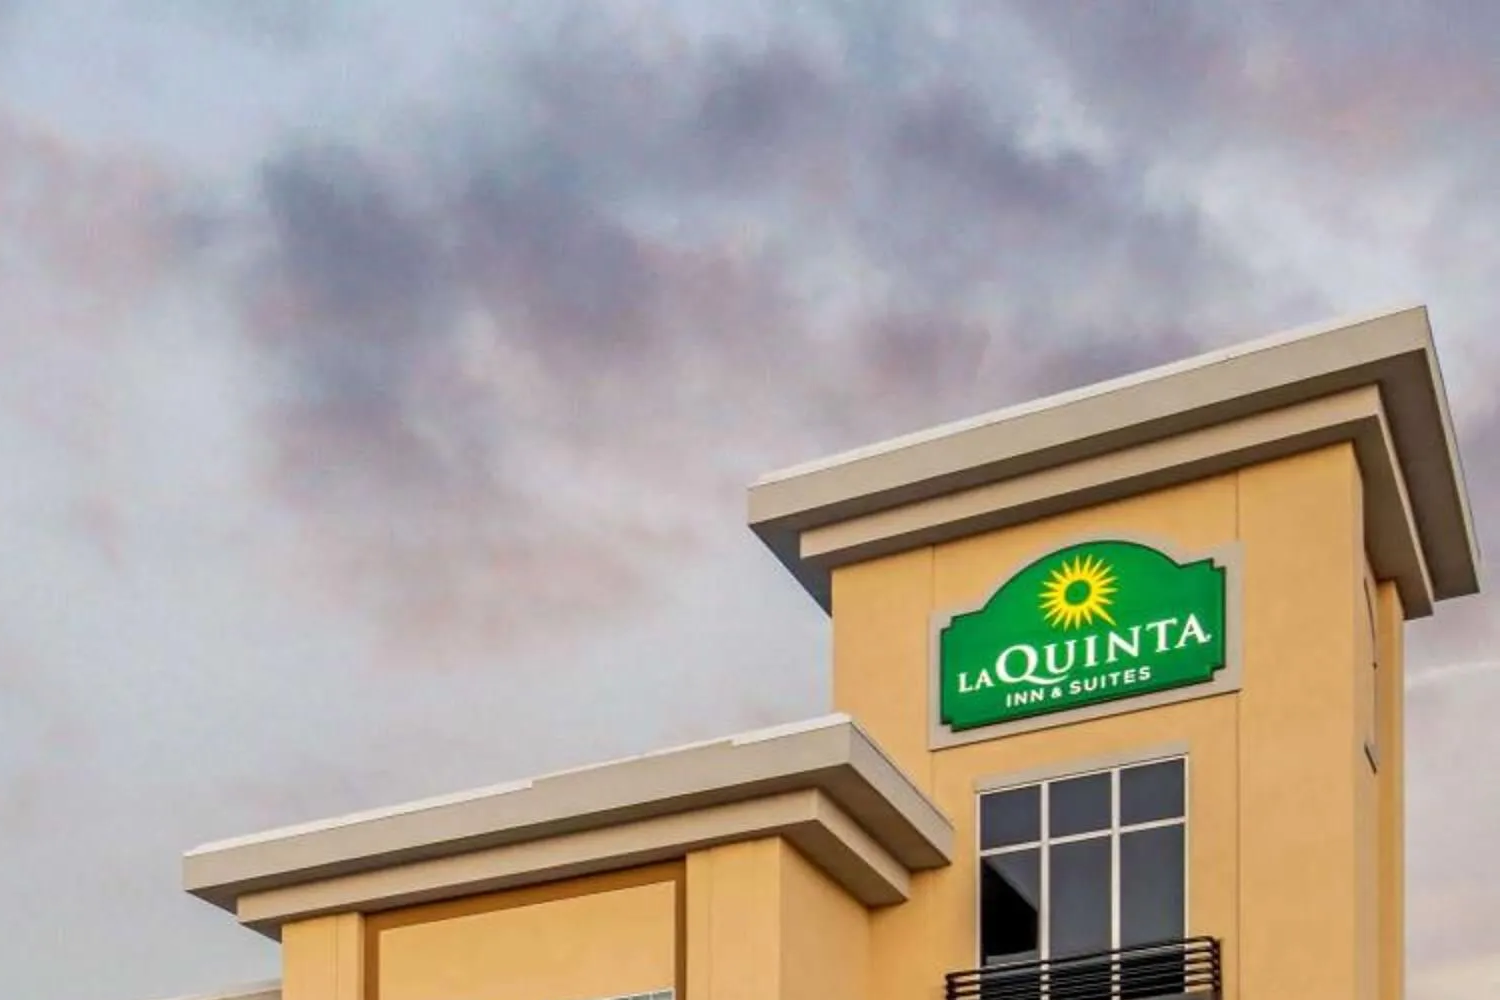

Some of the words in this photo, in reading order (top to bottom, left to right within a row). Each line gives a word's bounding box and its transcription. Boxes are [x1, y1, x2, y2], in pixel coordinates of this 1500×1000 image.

[957, 668, 995, 693] LA
[996, 613, 1212, 685] QUINTA
[1006, 687, 1045, 708] INN
[1050, 686, 1063, 699] &
[1069, 665, 1151, 695] SUITES
